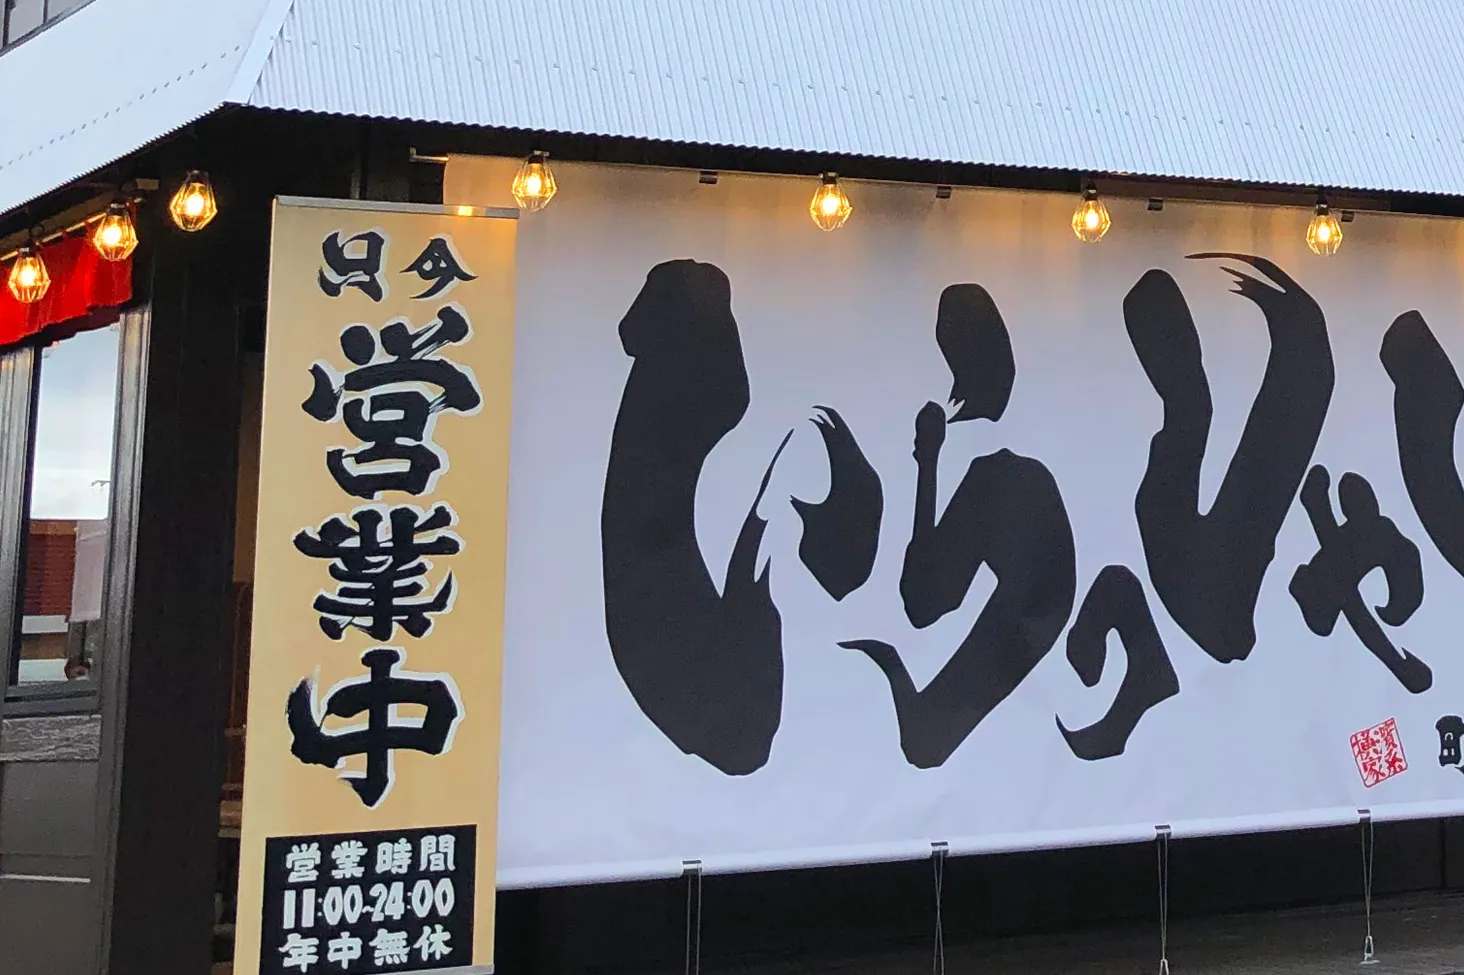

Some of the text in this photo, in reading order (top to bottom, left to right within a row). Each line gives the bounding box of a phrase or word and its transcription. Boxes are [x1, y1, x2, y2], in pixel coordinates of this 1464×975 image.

[319, 229, 477, 300] 只今
[287, 305, 481, 807] 営業中
[286, 835, 456, 883] 営業時間
[283, 878, 455, 929] 11:00~24:00
[278, 924, 453, 973] 年中無休
